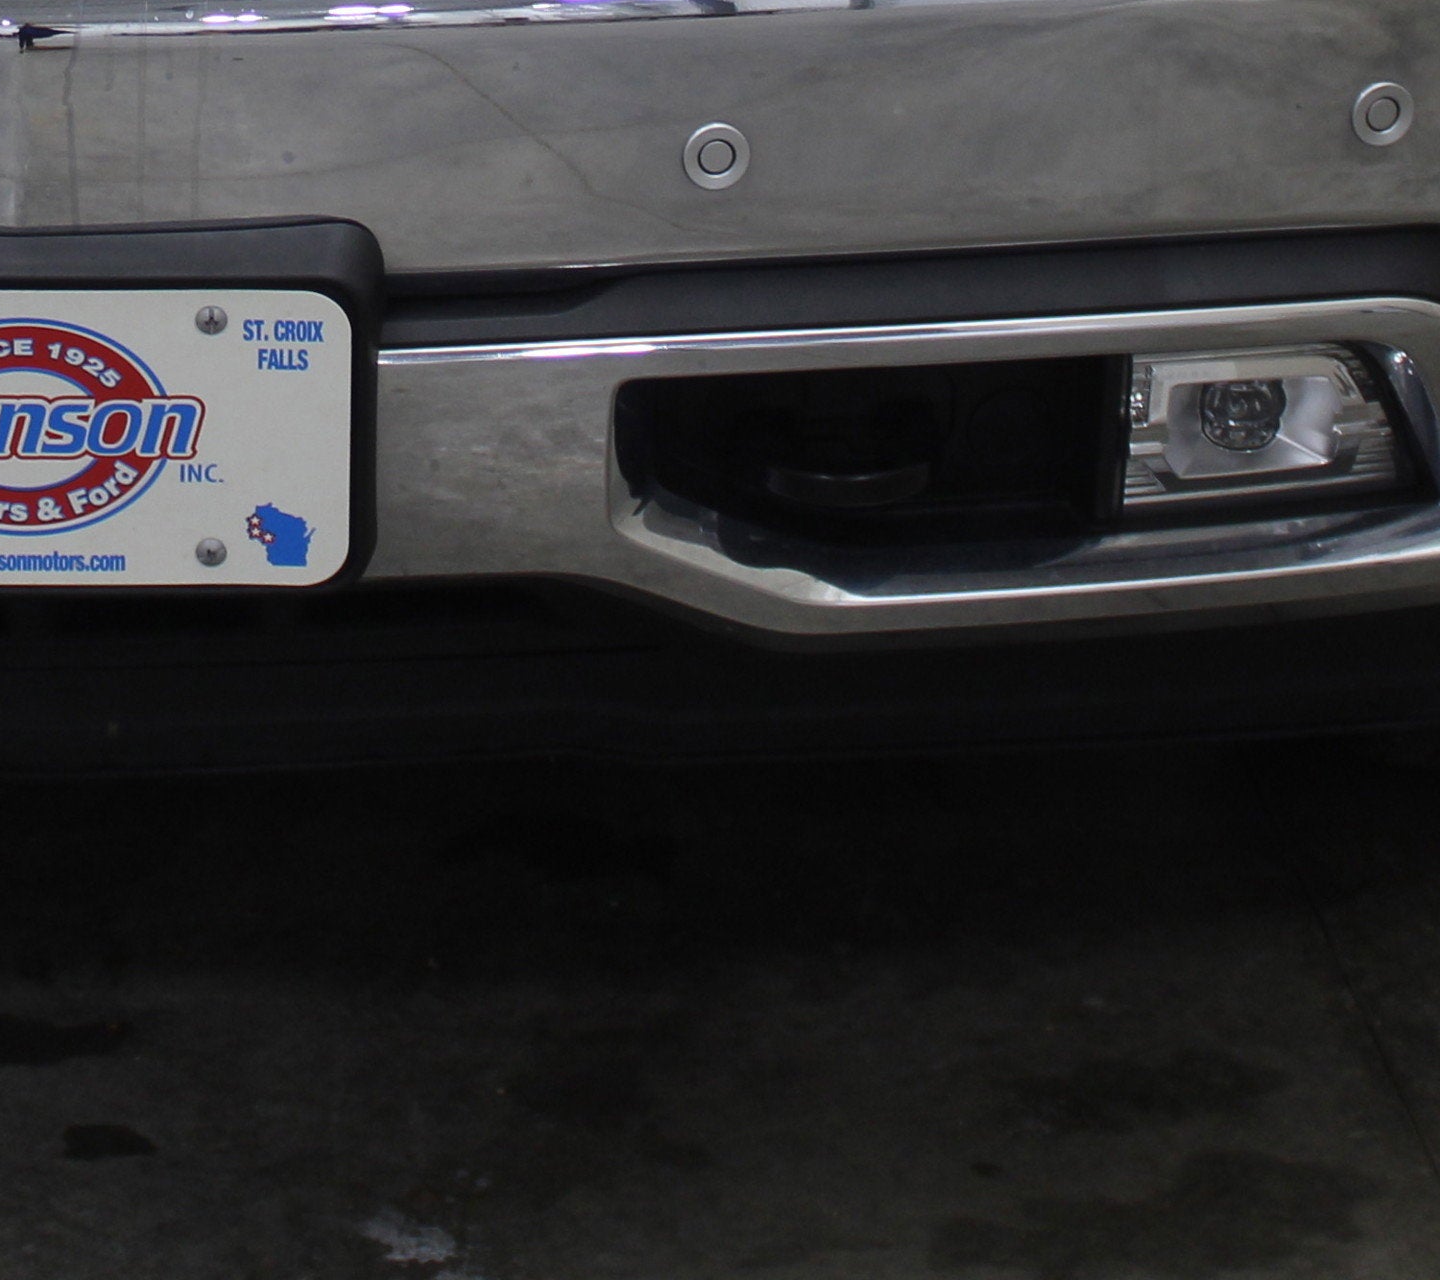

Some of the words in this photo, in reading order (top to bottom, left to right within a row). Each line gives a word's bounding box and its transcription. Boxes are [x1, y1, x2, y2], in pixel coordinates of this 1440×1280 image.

[242, 319, 269, 341] ST.
[273, 320, 324, 342] CROIX
[47, 342, 122, 388] 1925
[257, 348, 309, 371] FALLS
[180, 463, 224, 483] INC.
[36, 497, 64, 522] &
[66, 461, 139, 515] Ford
